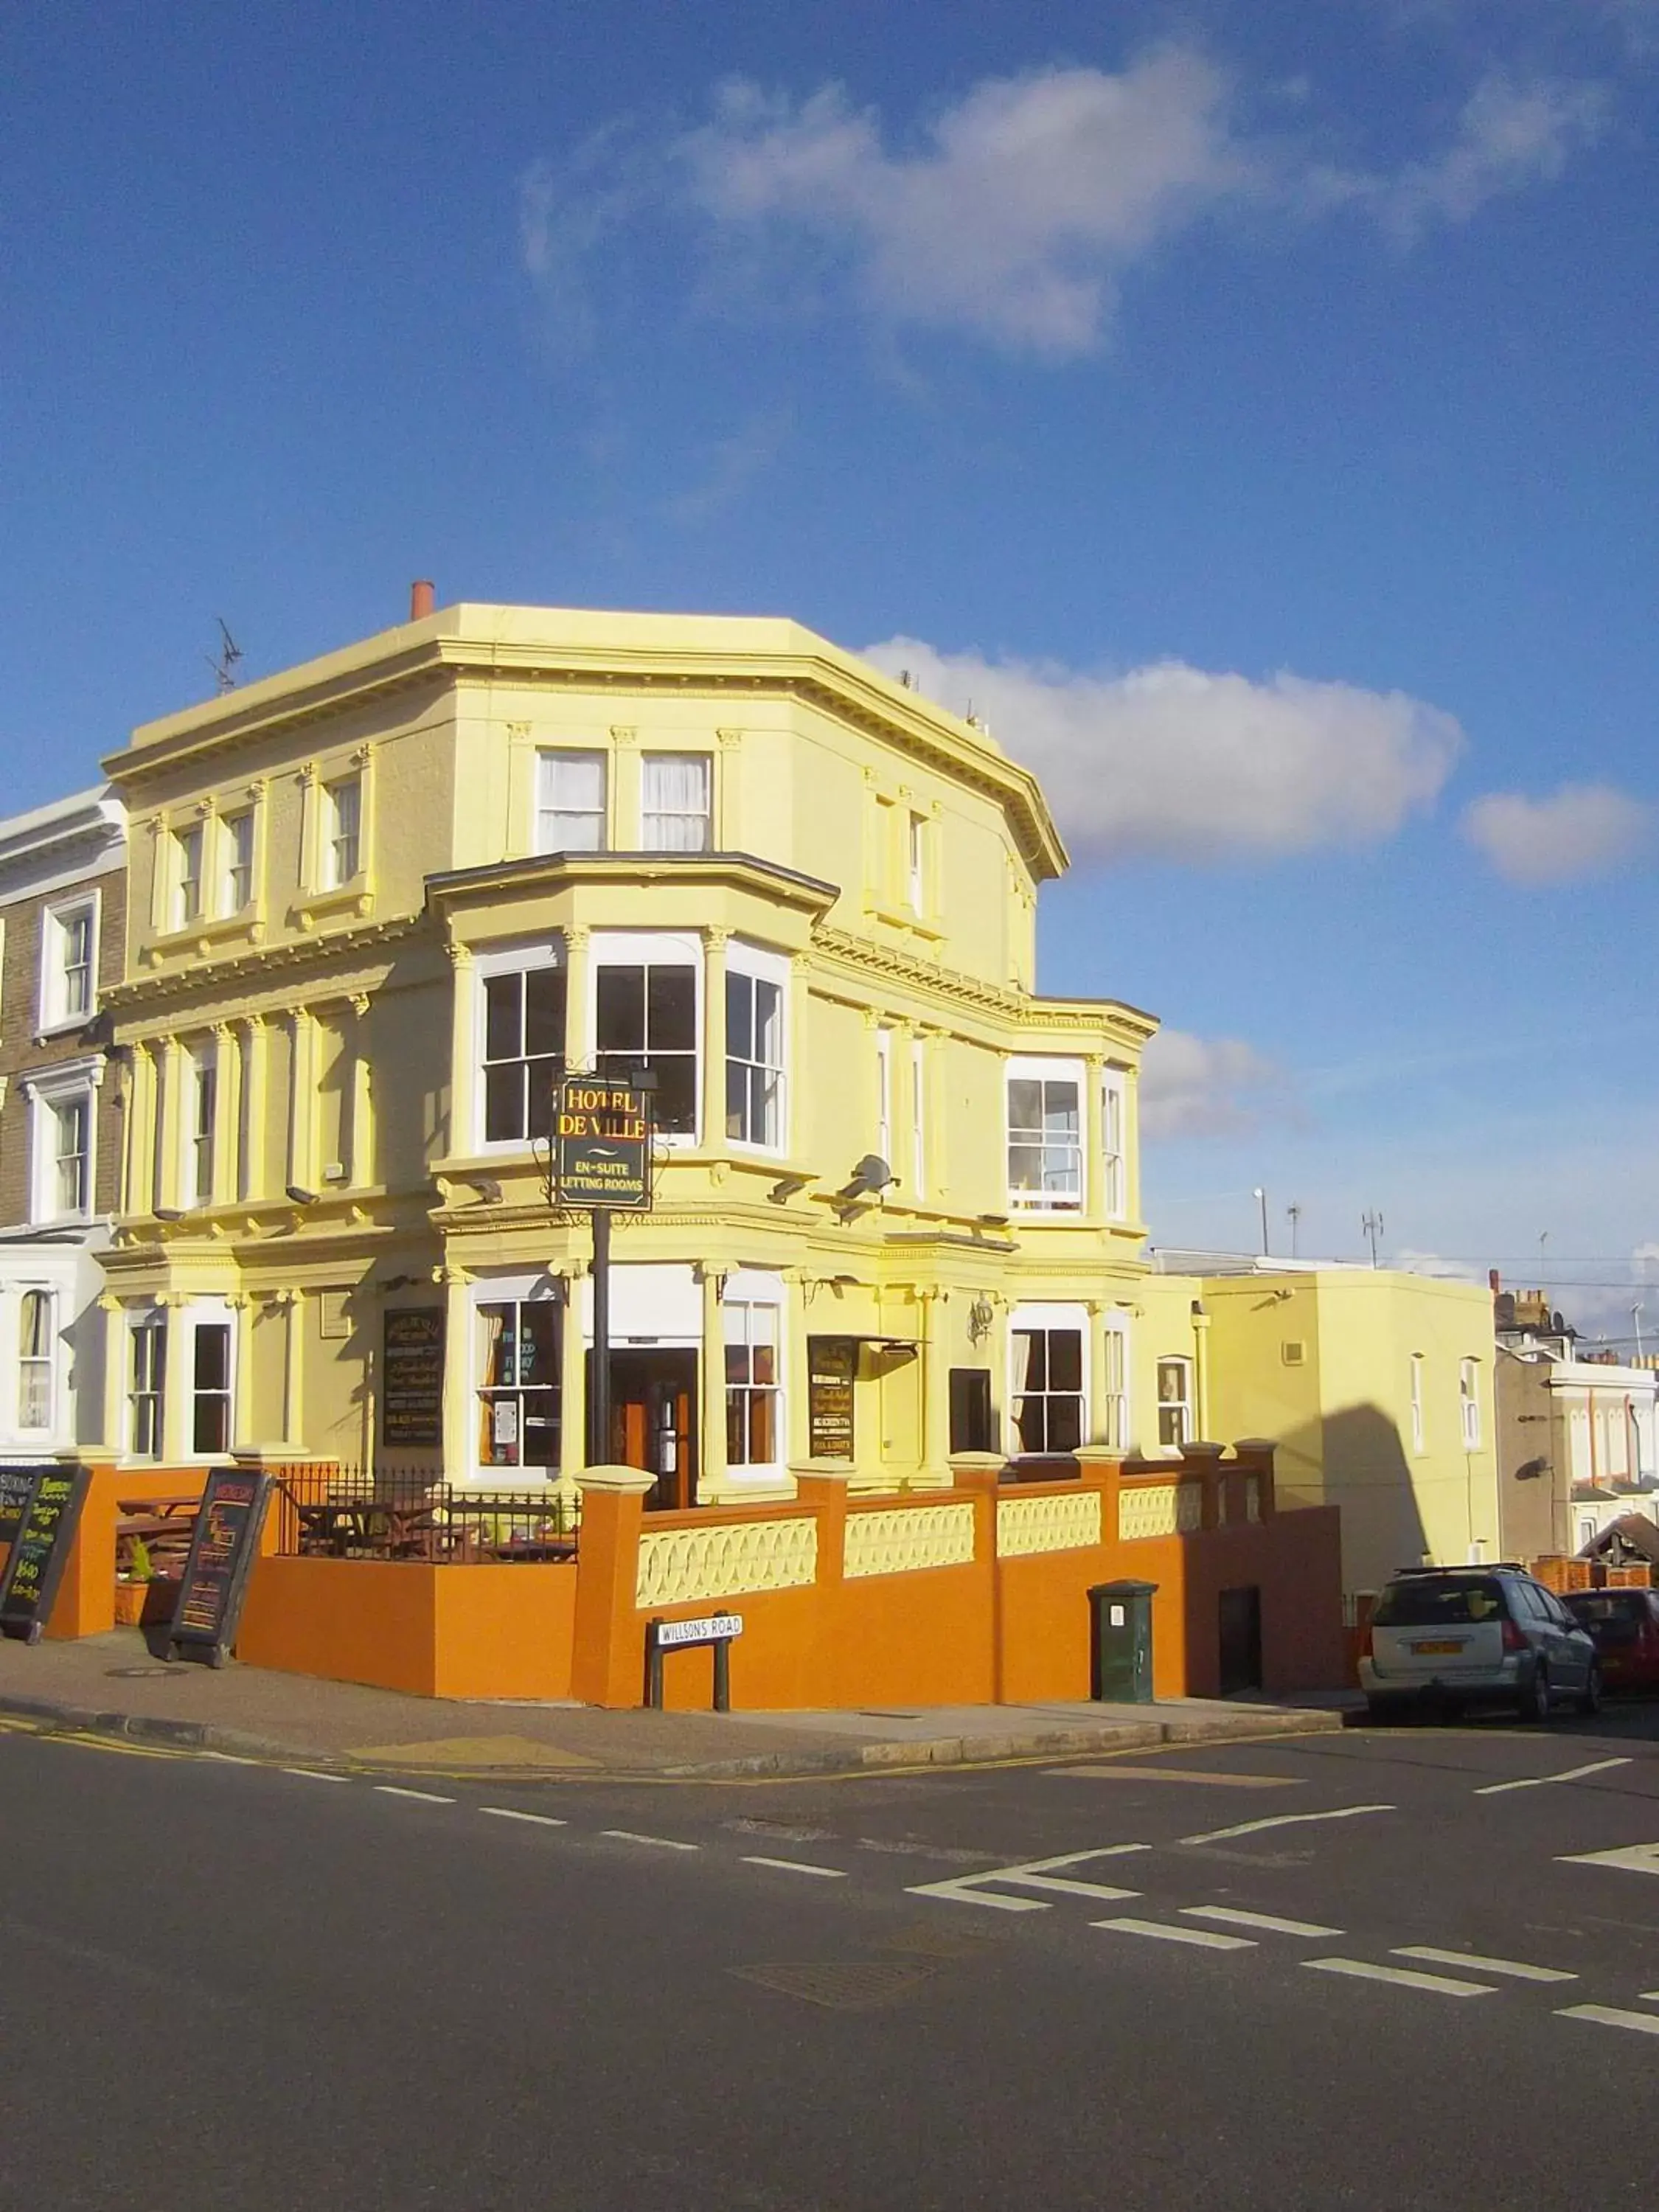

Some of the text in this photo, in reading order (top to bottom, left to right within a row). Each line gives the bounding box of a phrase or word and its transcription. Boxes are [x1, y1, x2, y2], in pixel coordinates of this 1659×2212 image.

[568, 1088, 638, 1113] HOTEL
[560, 1115, 646, 1139] DE VILLE
[575, 1161, 629, 1175] EN-SUITE
[560, 1176, 644, 1192] LETTING ROOMS
[662, 1617, 740, 1641] WILLSONS ROAD
